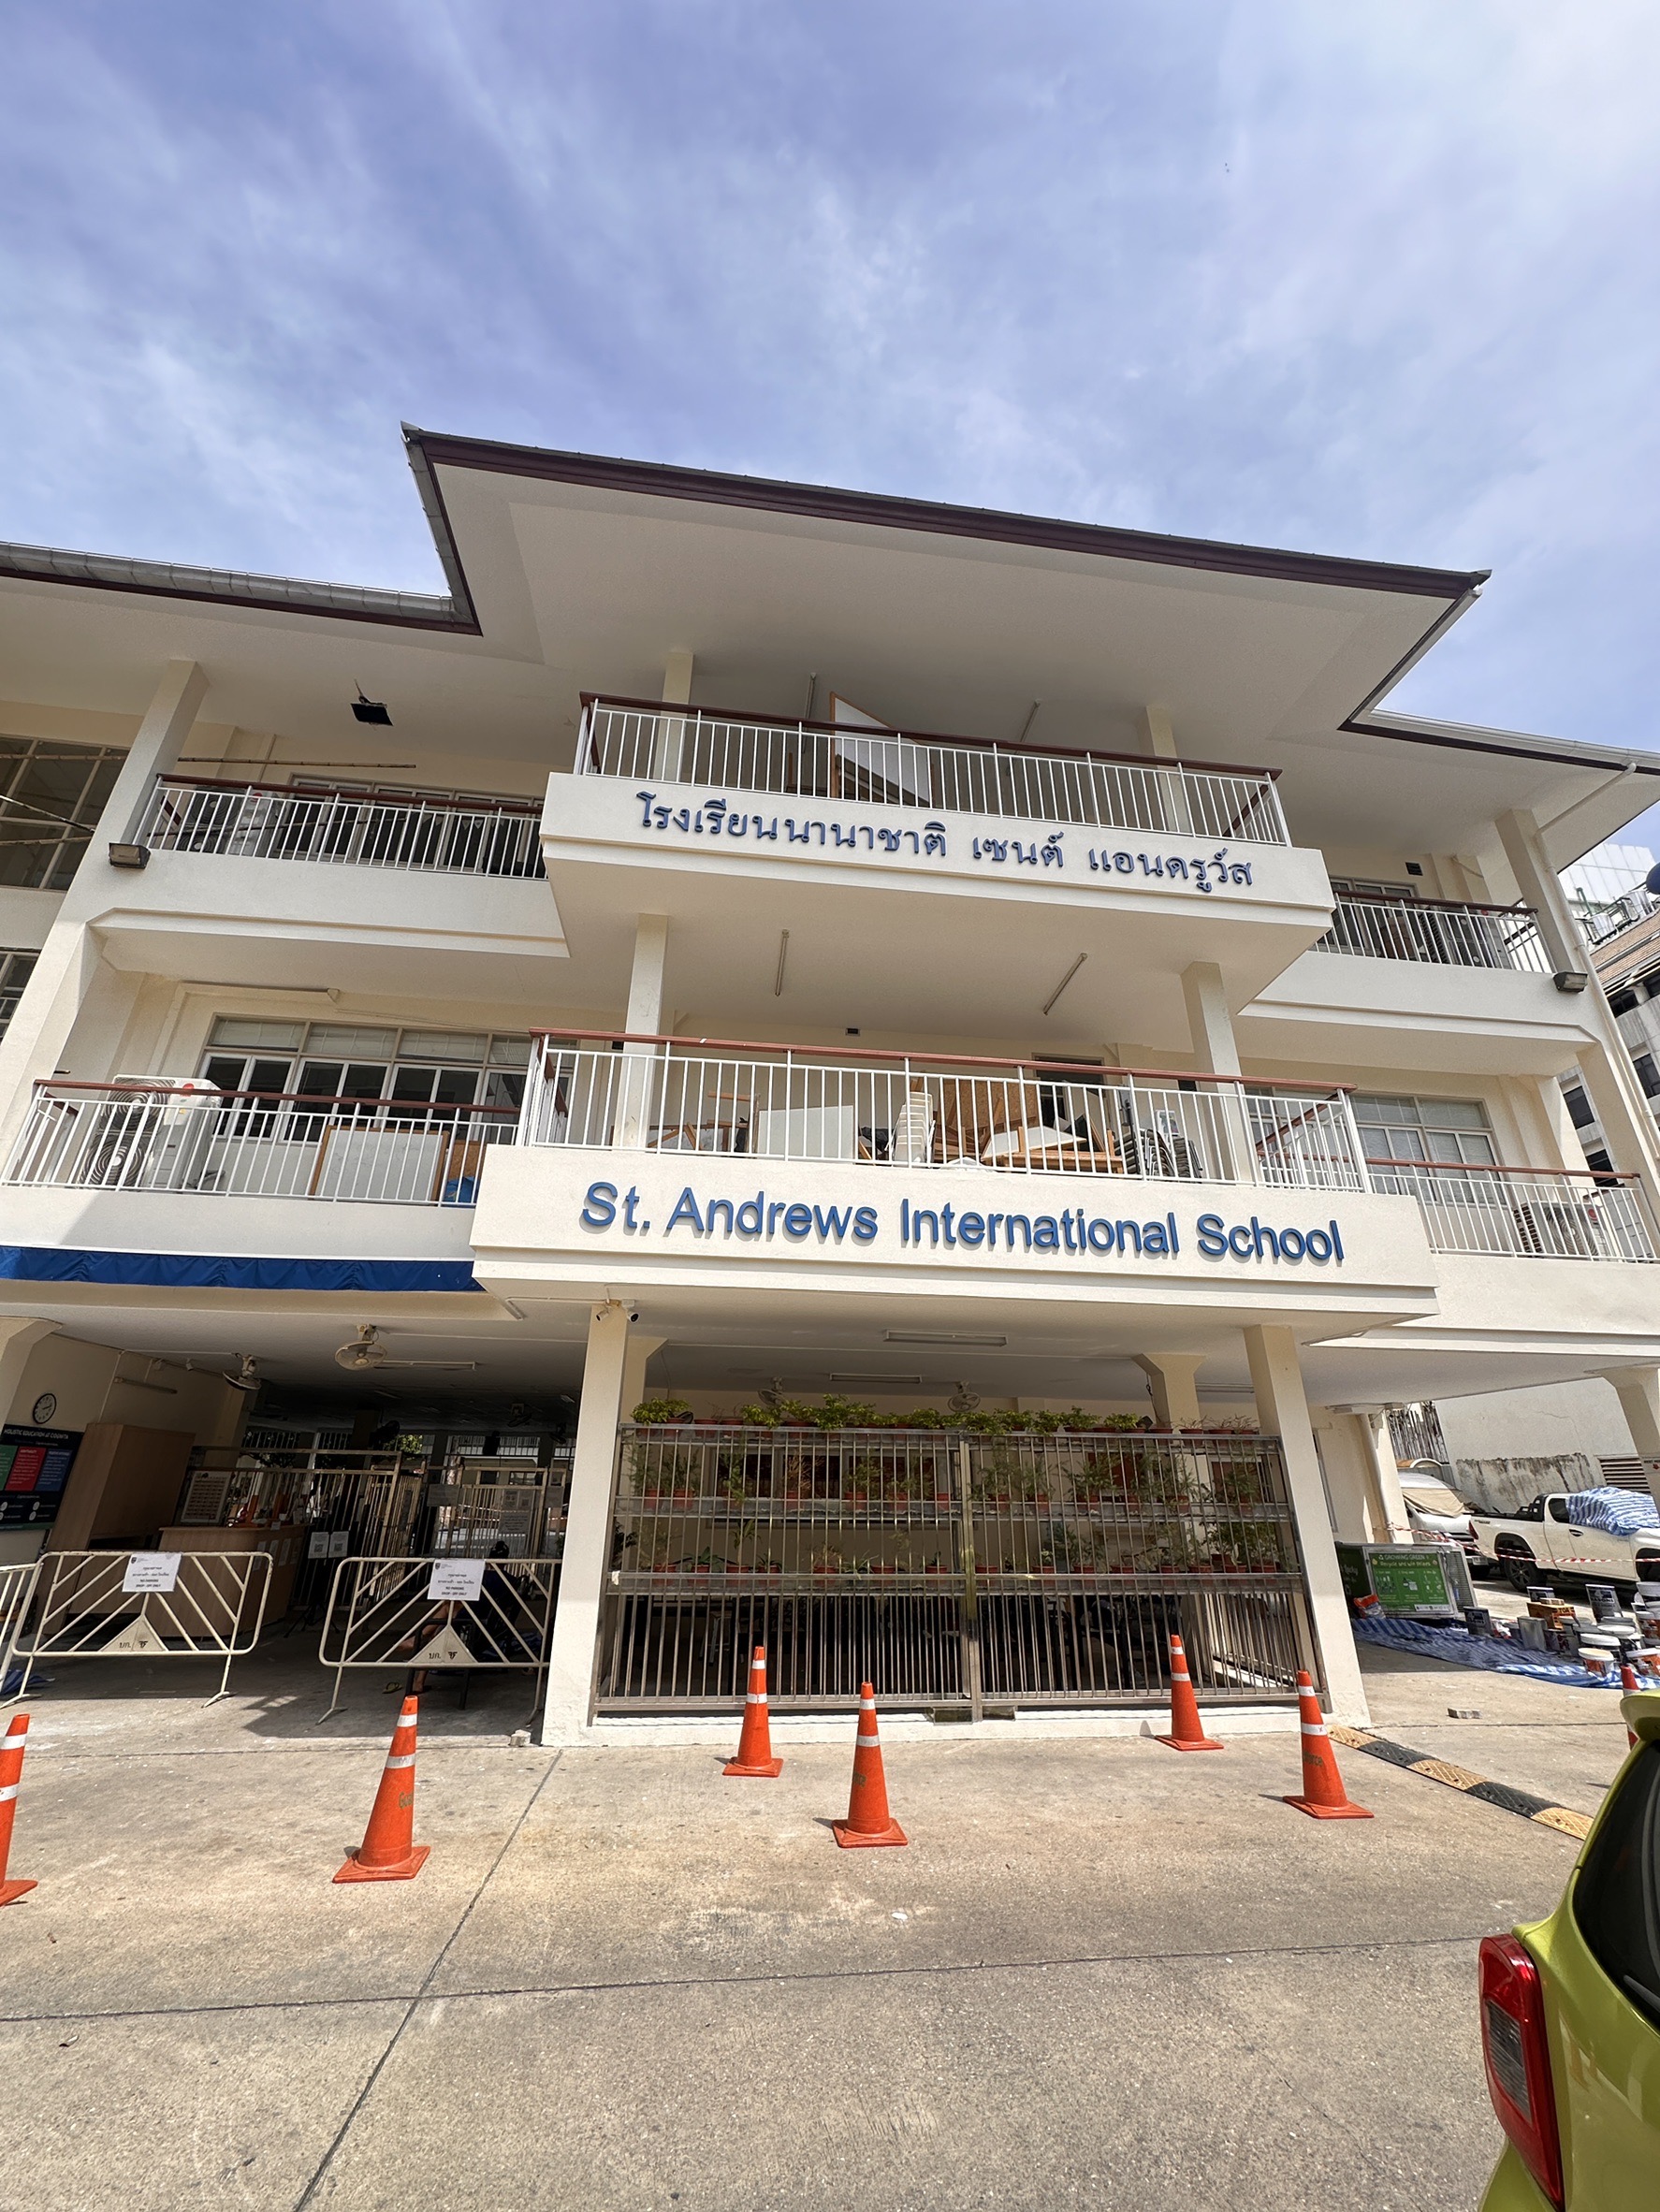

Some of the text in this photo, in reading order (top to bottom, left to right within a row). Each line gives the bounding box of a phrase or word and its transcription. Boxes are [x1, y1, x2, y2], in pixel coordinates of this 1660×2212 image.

[635, 791, 1253, 893] โรงเรียนนานาชาติ เซนต์ แอนดรูว์ส
[582, 1182, 1346, 1261] St. Andrews International School
